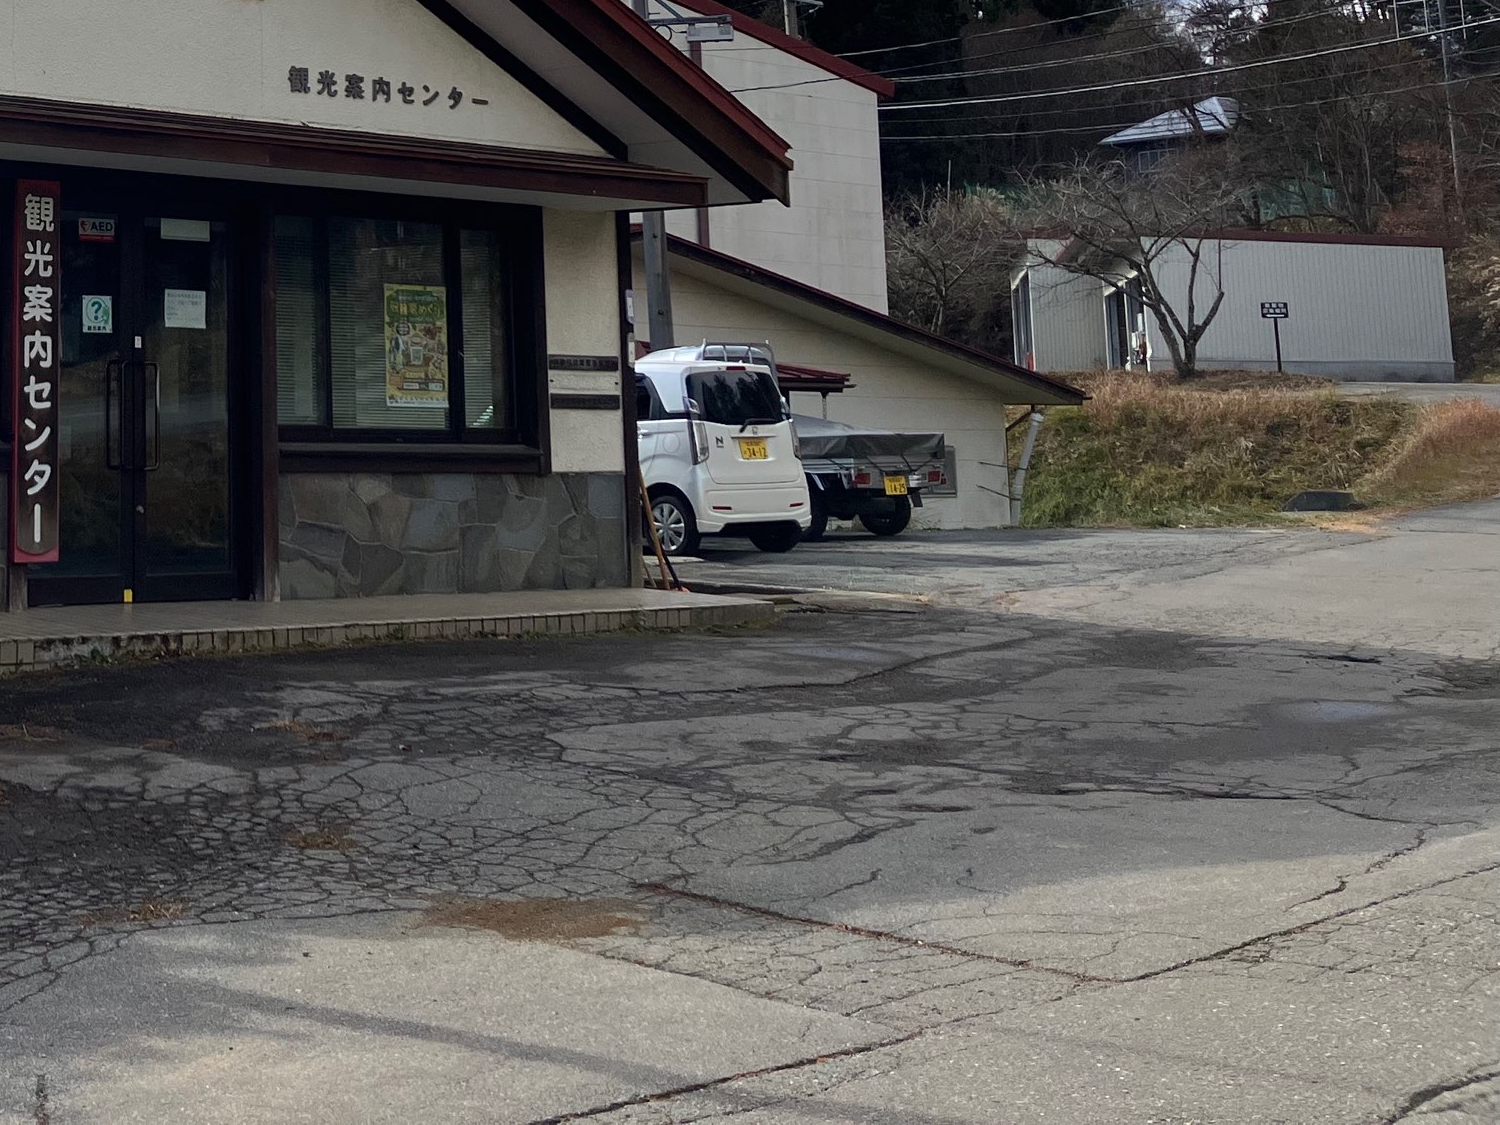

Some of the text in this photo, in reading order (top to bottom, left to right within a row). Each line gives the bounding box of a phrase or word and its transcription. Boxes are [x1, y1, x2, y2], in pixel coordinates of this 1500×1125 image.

[288, 65, 490, 110] 観光案内センター
[90, 221, 113, 232] AED
[23, 192, 55, 544] 観光案内センター
